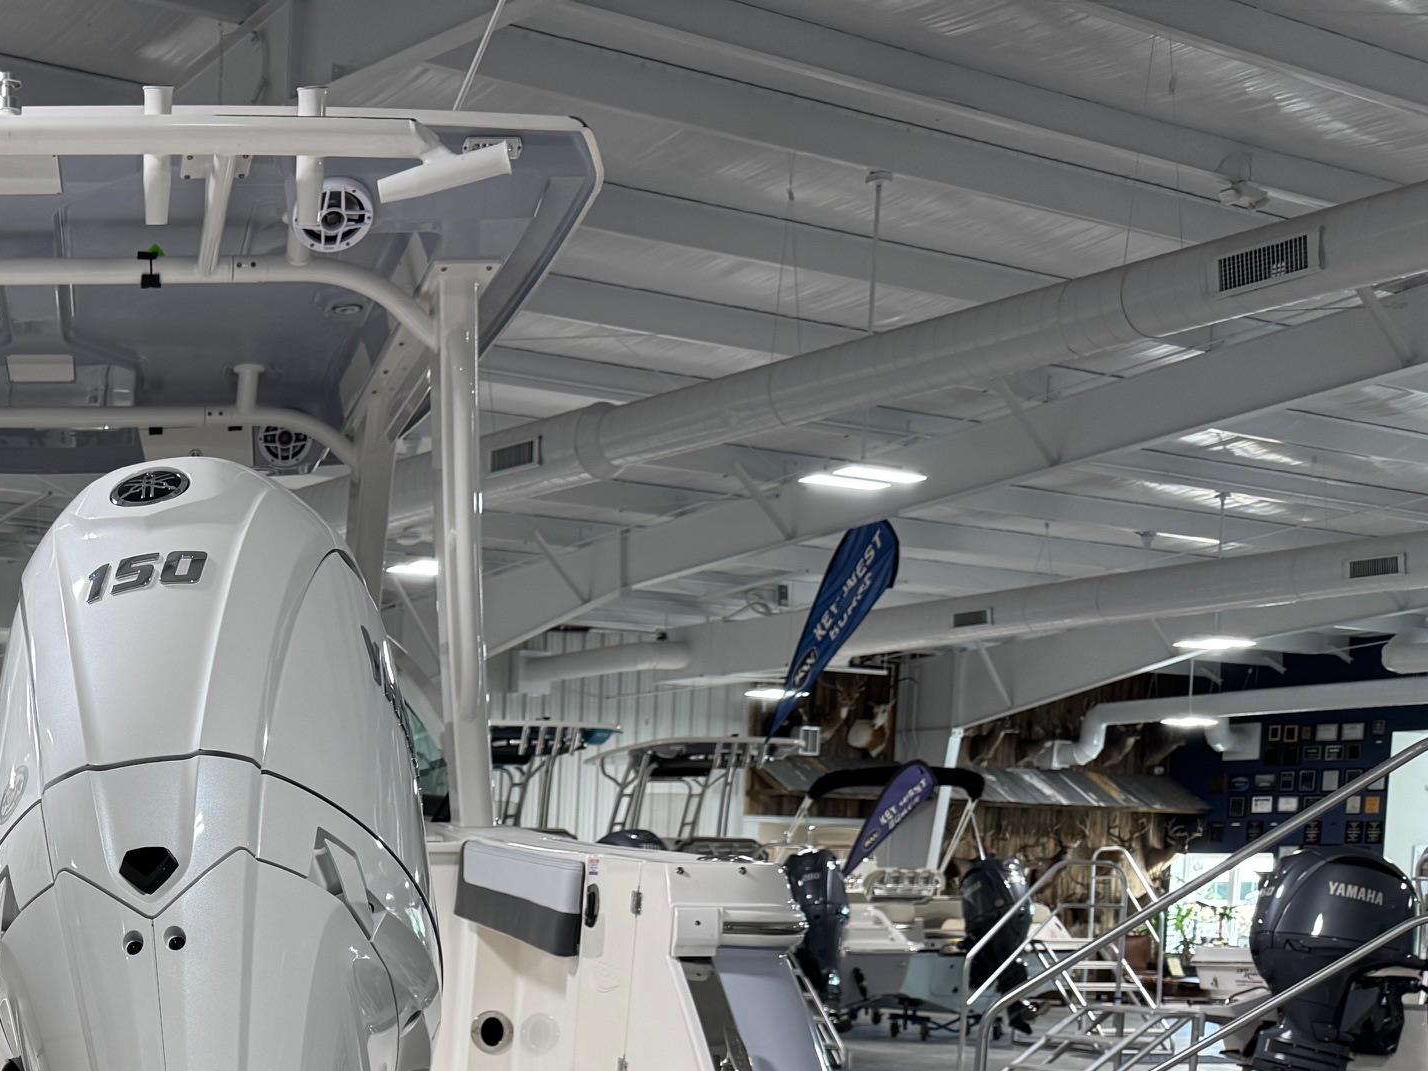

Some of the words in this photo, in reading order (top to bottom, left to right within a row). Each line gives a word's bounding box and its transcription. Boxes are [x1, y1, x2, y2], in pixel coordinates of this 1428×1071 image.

[86, 551, 209, 605] 150
[842, 528, 884, 598] WEST
[1328, 880, 1384, 906] YAMAHA
